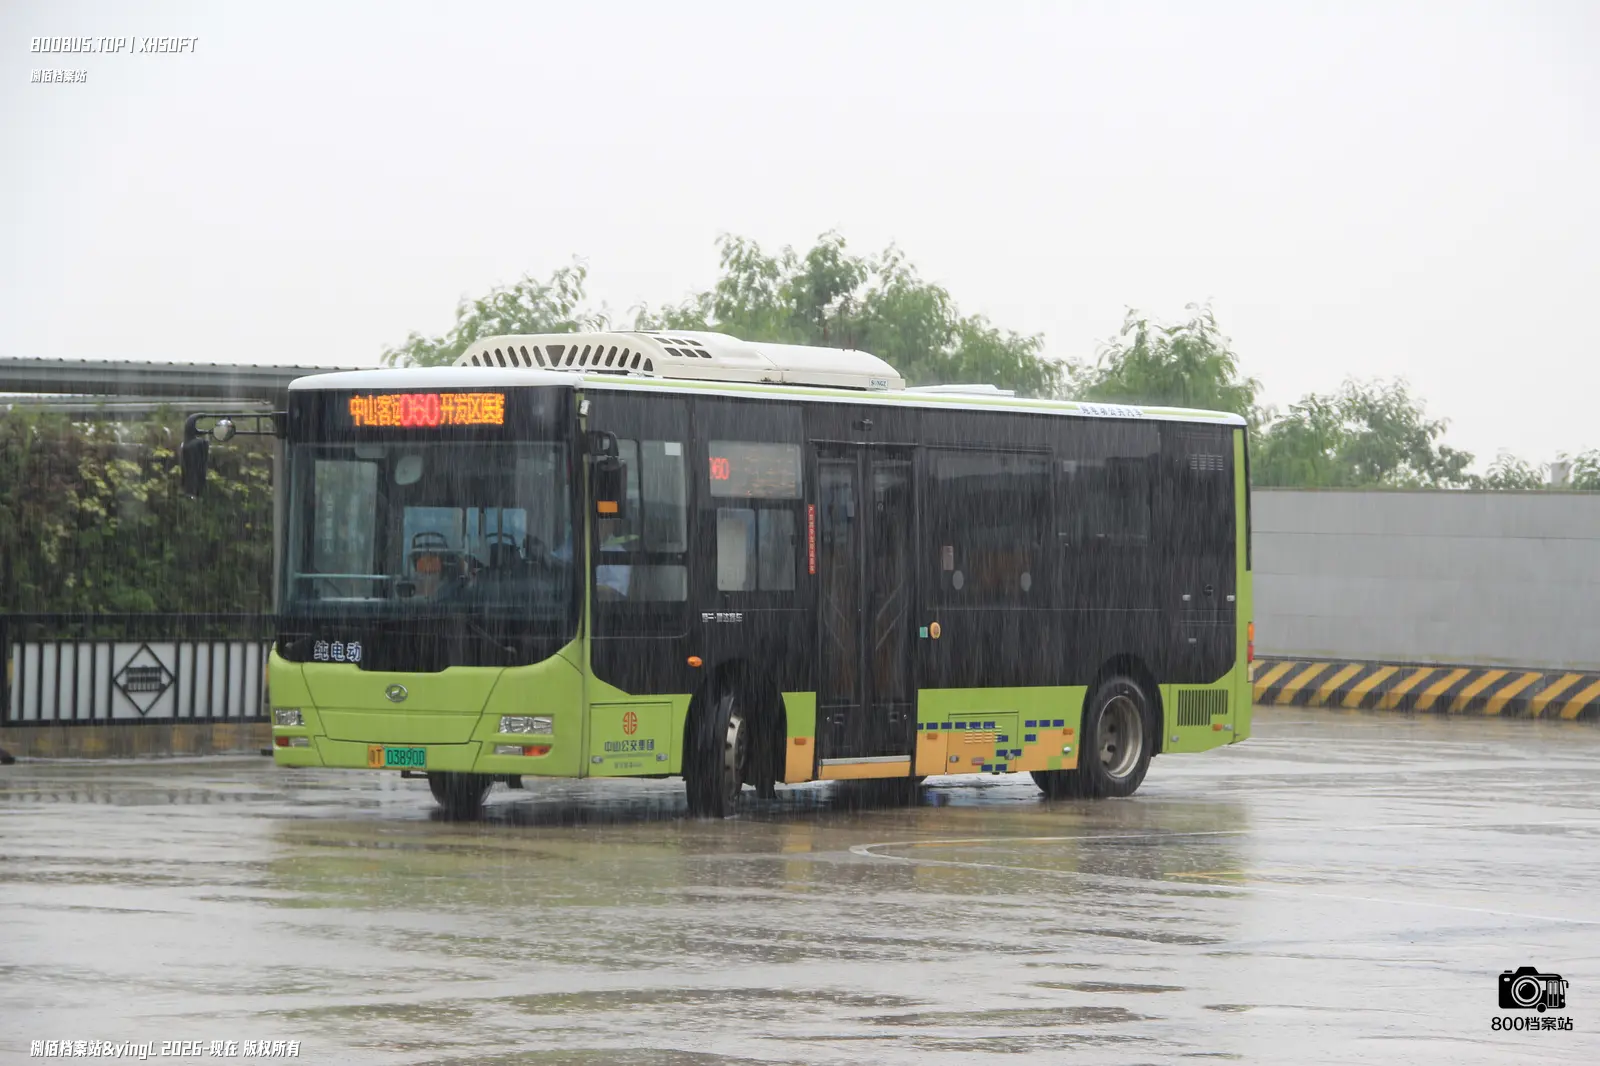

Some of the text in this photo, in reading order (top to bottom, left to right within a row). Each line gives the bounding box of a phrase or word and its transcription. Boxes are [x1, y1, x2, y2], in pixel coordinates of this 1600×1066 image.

[313, 640, 362, 662] 纯电动
[604, 739, 655, 752] 中山公交集团
